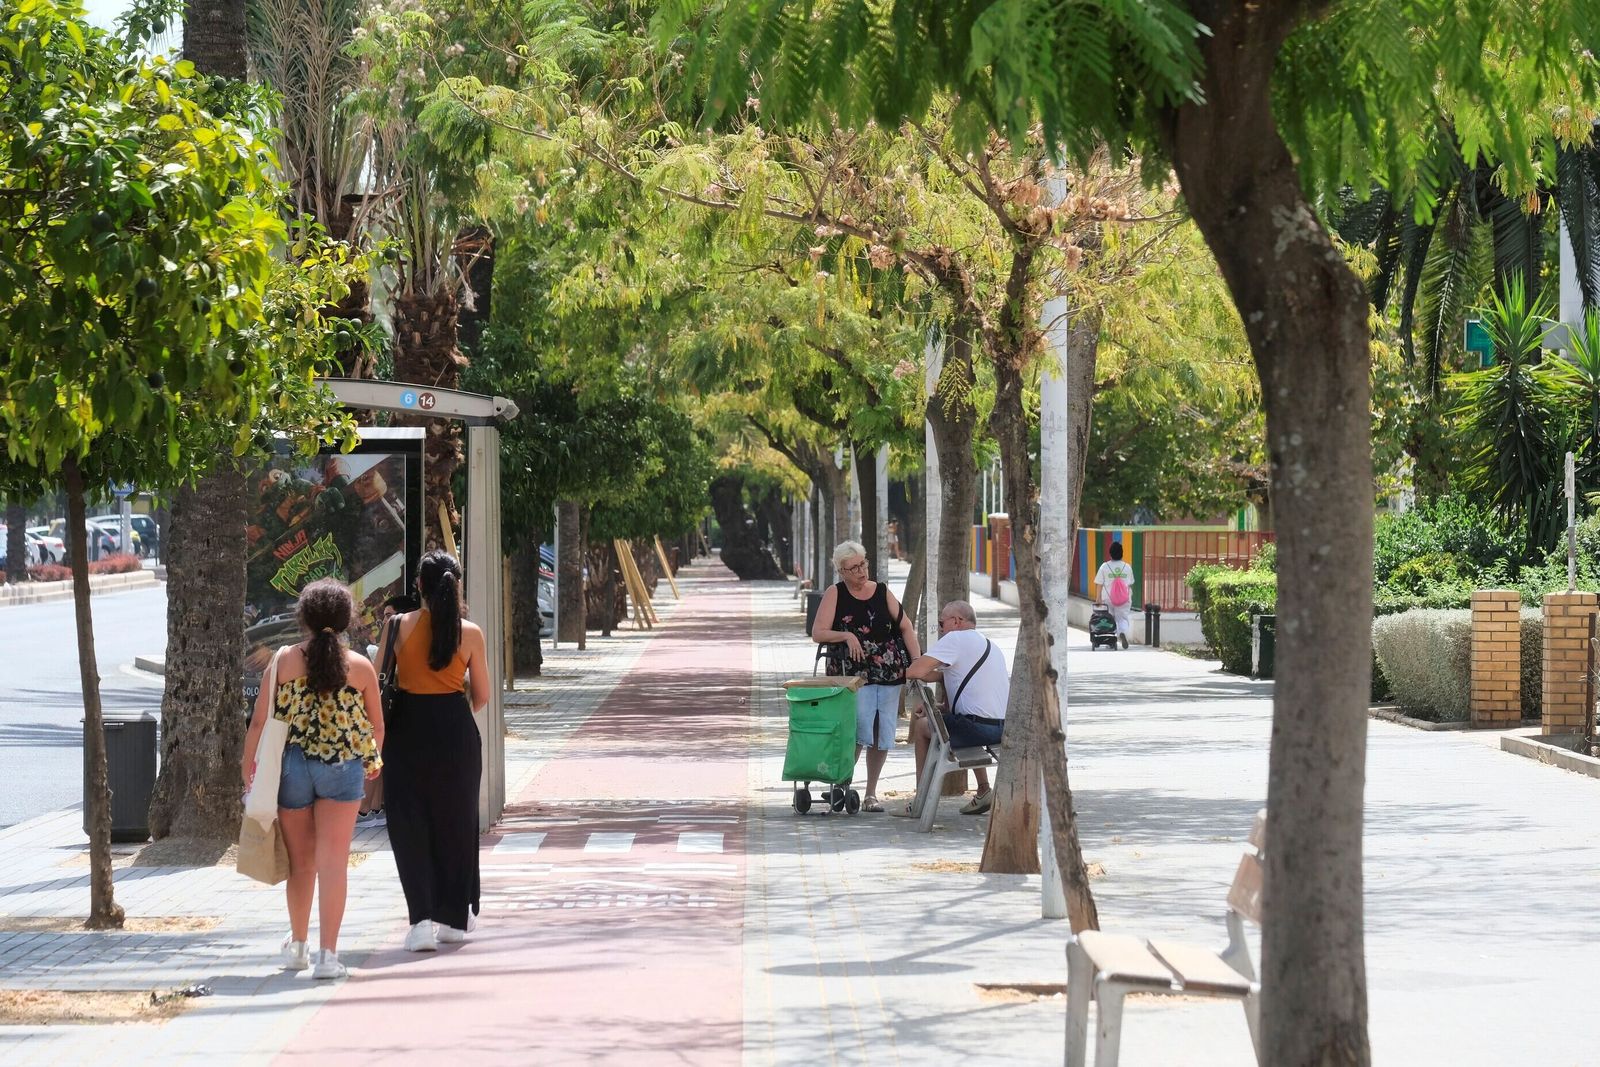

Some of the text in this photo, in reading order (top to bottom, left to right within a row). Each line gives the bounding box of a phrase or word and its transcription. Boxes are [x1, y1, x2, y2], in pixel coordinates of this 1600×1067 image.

[404, 393, 434, 407] 6 14
[272, 528, 308, 560] NINJA
[269, 531, 343, 597] TURTLES
[242, 686, 260, 697] SOLO
